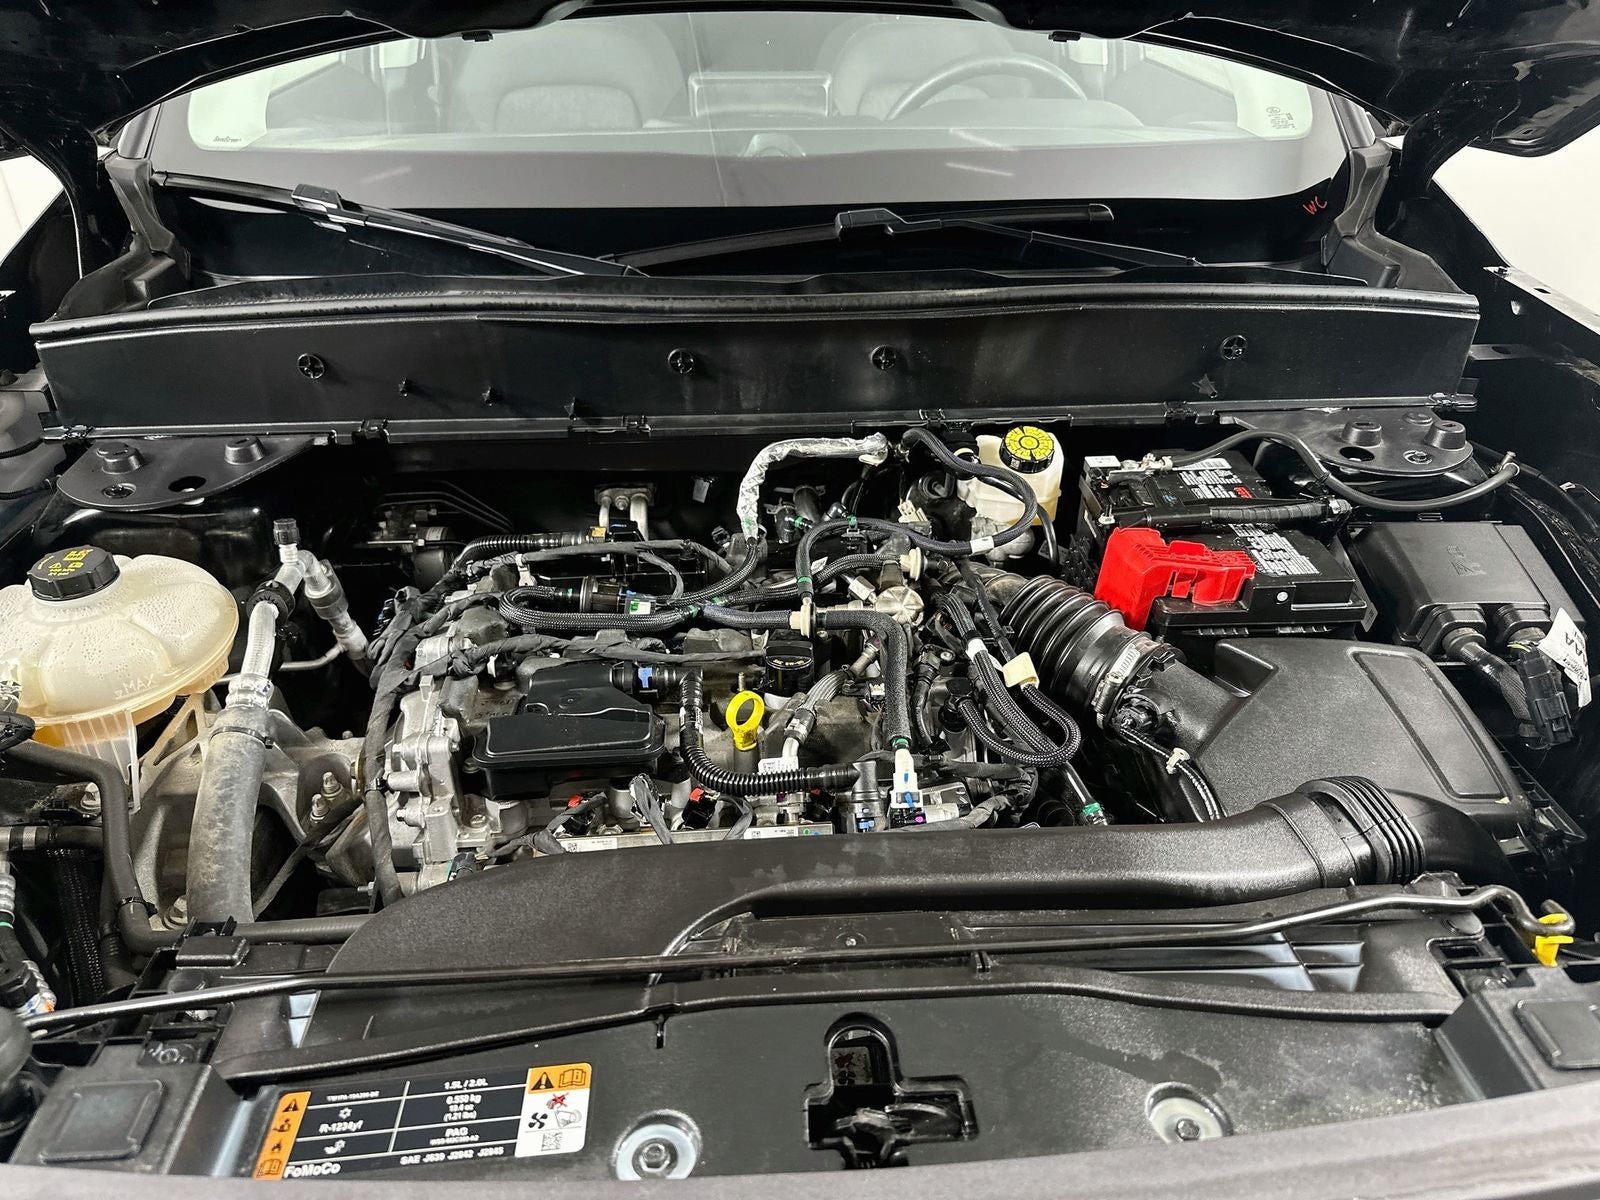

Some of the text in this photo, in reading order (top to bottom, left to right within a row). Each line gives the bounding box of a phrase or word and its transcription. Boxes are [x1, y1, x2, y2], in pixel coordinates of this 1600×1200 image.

[1302, 195, 1328, 215] WC
[122, 672, 157, 694] MAX
[400, 1154, 421, 1165] SAE
[283, 1162, 341, 1178] FoMoCo
